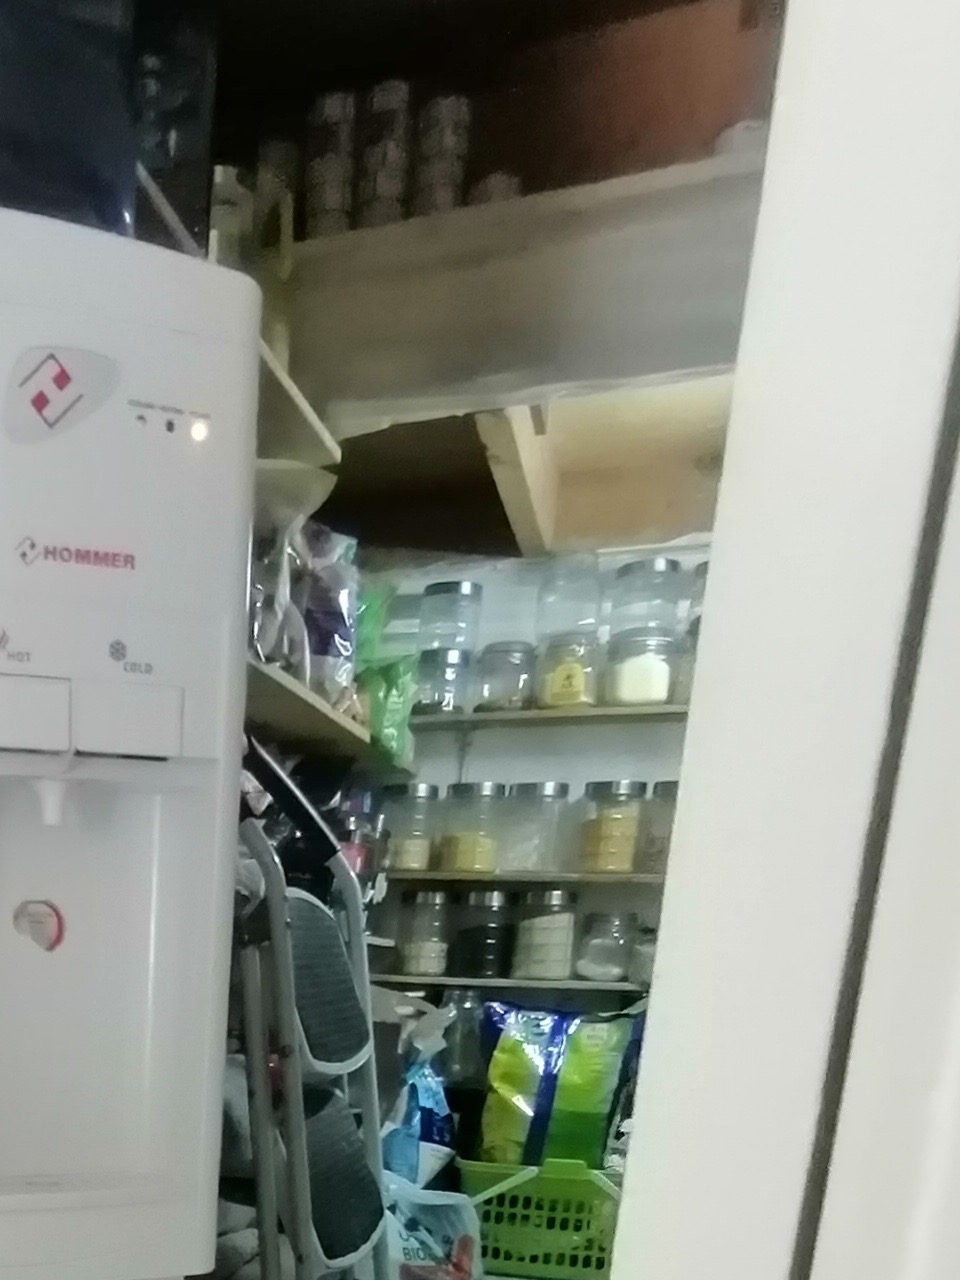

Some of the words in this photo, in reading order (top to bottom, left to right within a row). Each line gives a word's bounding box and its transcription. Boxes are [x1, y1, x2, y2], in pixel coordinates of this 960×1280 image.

[42, 544, 136, 570] HOMMER
[7, 651, 32, 663] HOT
[123, 661, 153, 675] COLD
